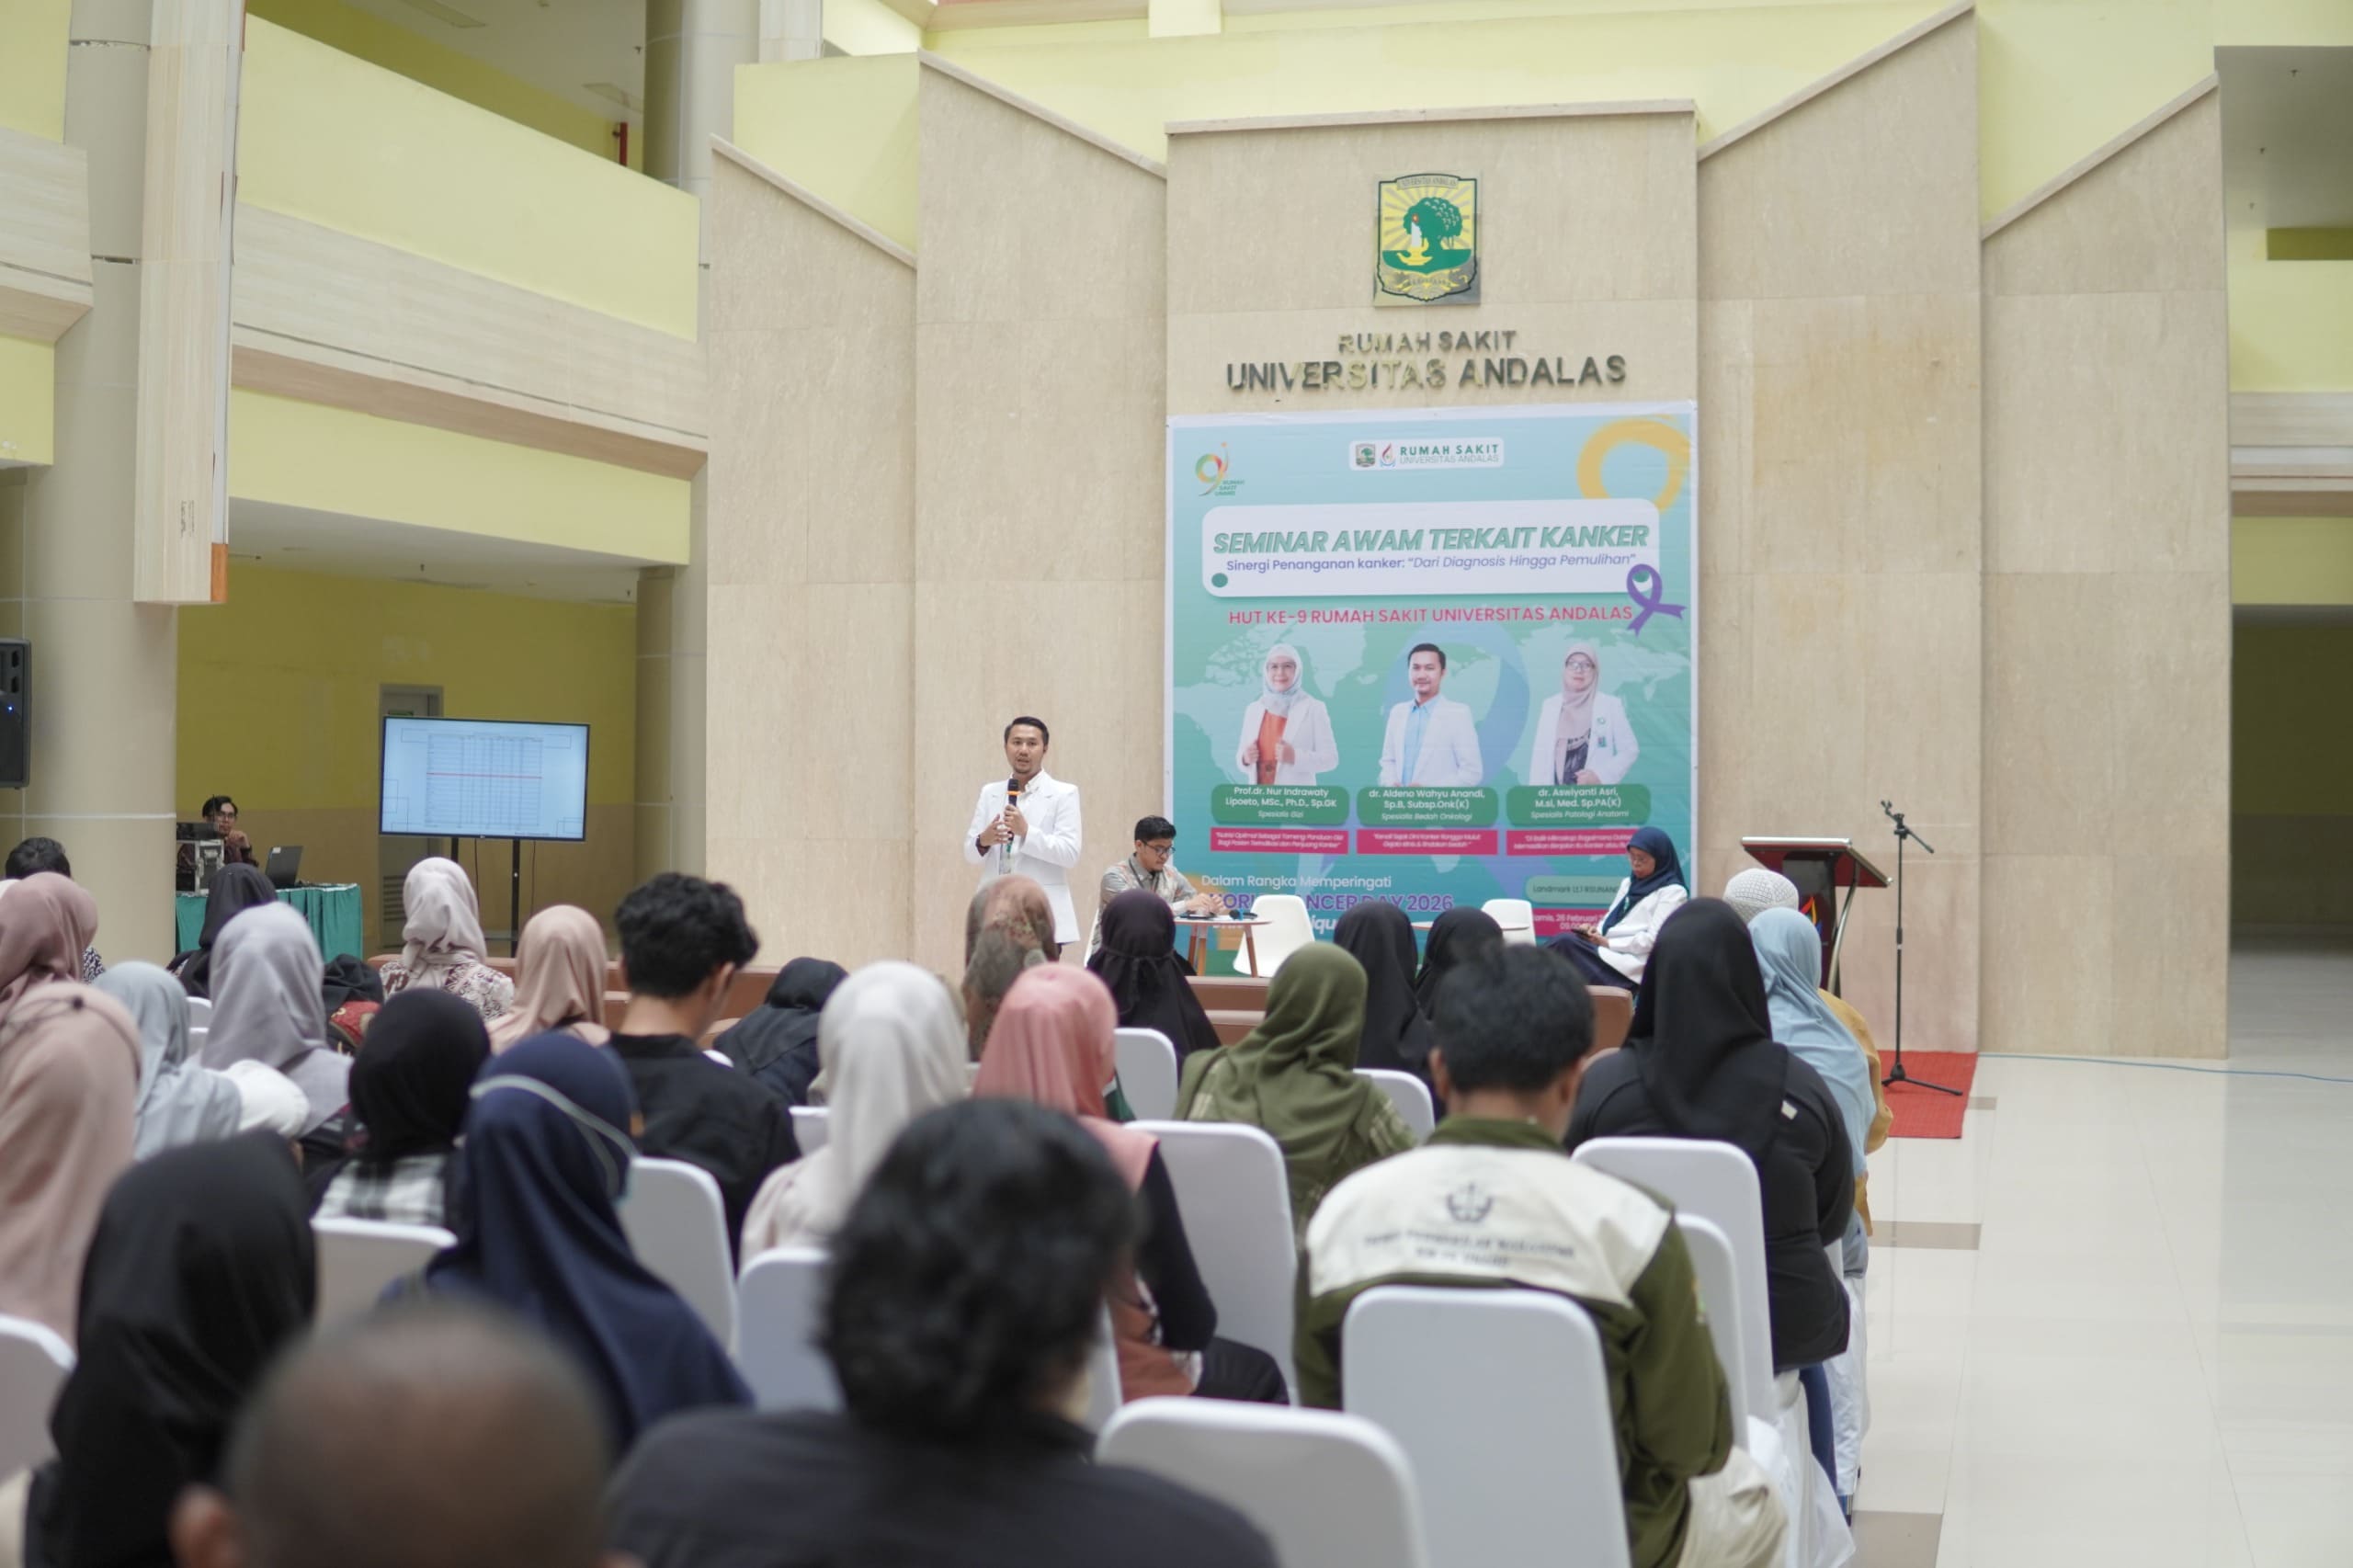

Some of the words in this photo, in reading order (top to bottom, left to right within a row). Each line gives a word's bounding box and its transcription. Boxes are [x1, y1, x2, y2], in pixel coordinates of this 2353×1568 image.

[1337, 331, 1431, 354] RUMAH
[1439, 329, 1518, 351] SAKIT
[1226, 358, 1447, 391] UNIVERSITAS
[1459, 354, 1627, 388] ANDALAS
[1400, 445, 1449, 456] RUMAH
[1456, 444, 1499, 454] SAKIT
[1400, 455, 1455, 464] UNIVERSITAS
[1458, 454, 1500, 463] ANDALAS
[1213, 531, 1329, 553] SEMINAR
[1332, 528, 1425, 551] AWAM
[1429, 527, 1538, 550] TERKAIT
[1540, 525, 1650, 548] KANKER
[1226, 560, 1269, 574] Sinergi
[1273, 559, 1355, 573] Penanganan
[1358, 558, 1405, 570] kanker:
[1443, 555, 1506, 570] Diagnosis
[1509, 554, 1556, 570] Hingga
[1229, 610, 1263, 624] HUT
[1267, 610, 1308, 624] KE-9
[1311, 609, 1374, 623] RUMAH
[1379, 608, 1427, 623] SAKIT
[1432, 607, 1545, 622] UNIVERSITAS
[1549, 606, 1633, 620] ANDALAS
[1233, 787, 1265, 795] Prof.dr.
[1267, 788, 1282, 796] Nur
[1284, 787, 1329, 798] Indrawaty
[1369, 790, 1381, 798] dr.
[1416, 790, 1449, 799] Wahyu
[1539, 789, 1551, 797] dr.
[1225, 798, 1259, 807] Lipoeto,
[1201, 875, 1245, 887] Dalam
[1247, 875, 1297, 890] Rangka
[1300, 875, 1392, 892] Memperingati
[1406, 894, 1454, 911] 2026
